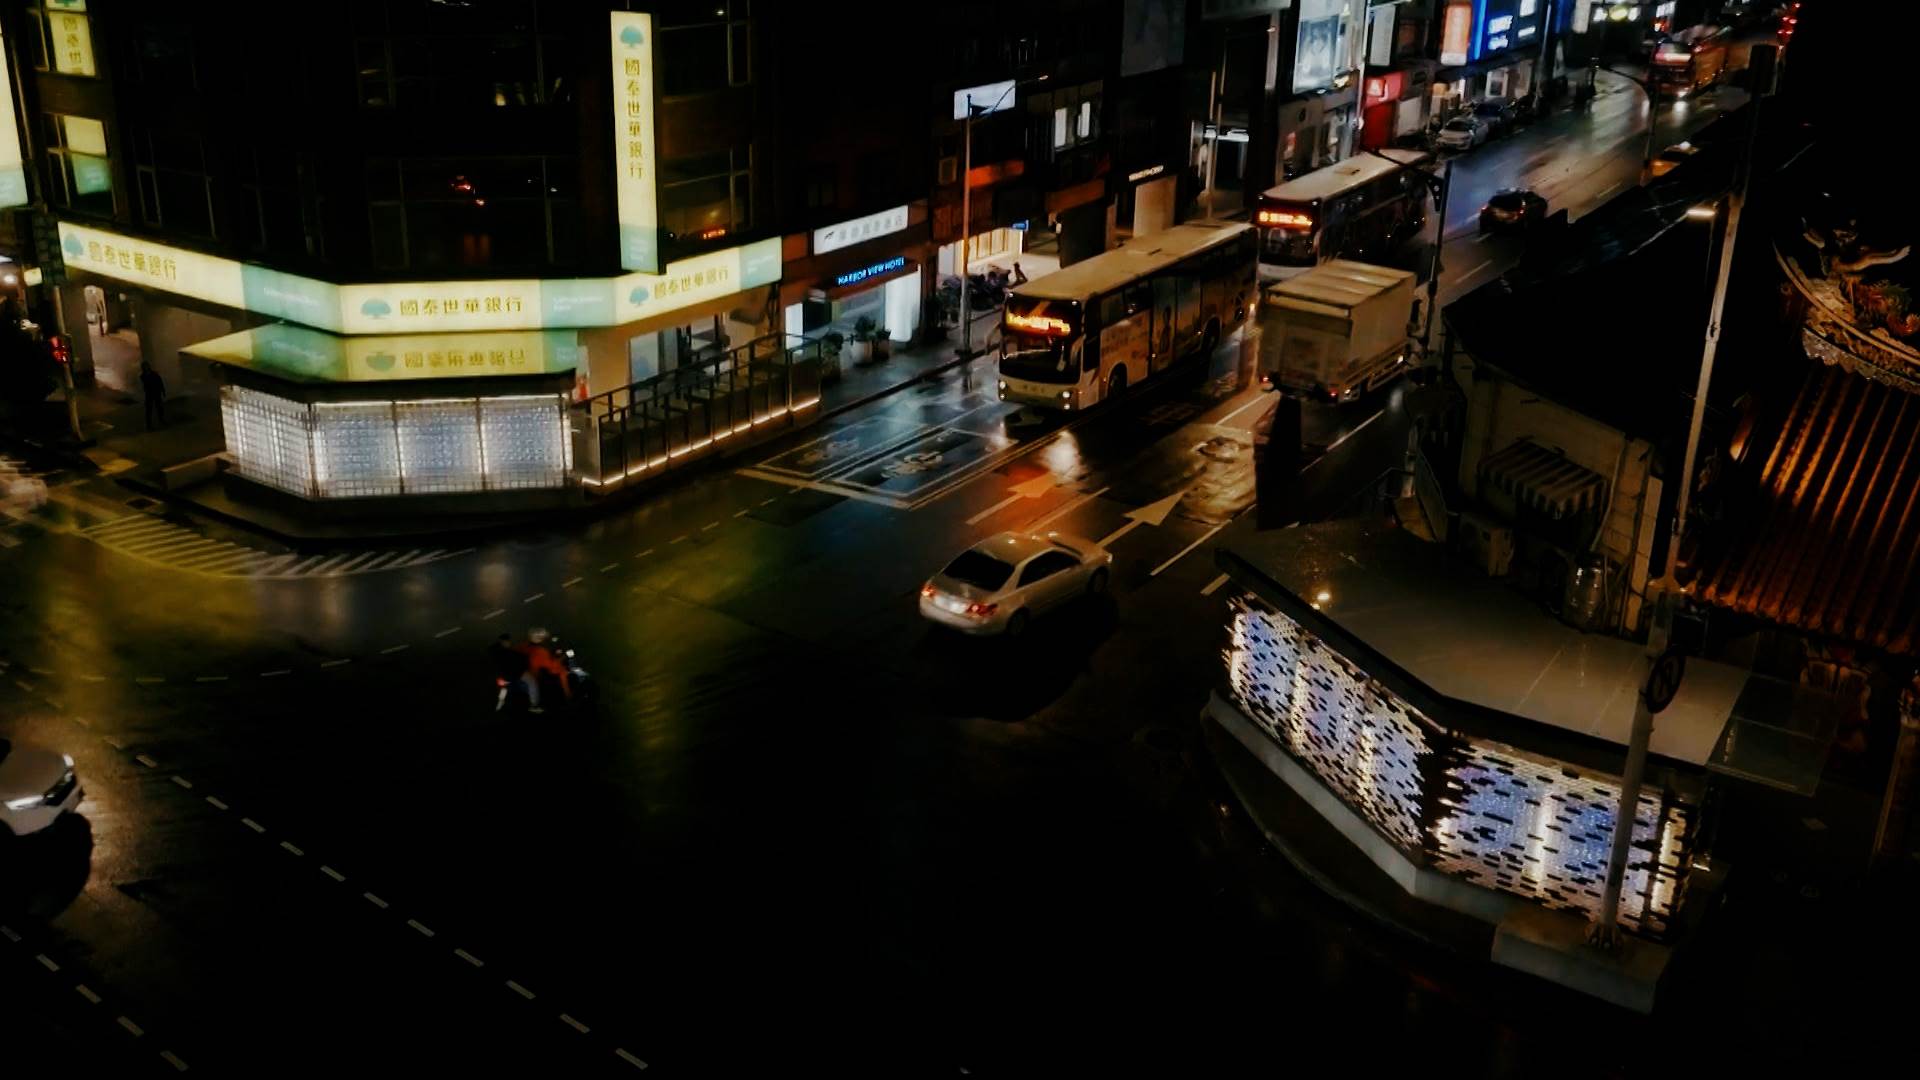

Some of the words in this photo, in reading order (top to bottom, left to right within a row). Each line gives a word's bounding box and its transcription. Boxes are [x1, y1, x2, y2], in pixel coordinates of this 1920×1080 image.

[624, 58, 643, 179] 國泰世華銀行
[87, 240, 177, 281] 國泰世華銀行
[838, 269, 867, 286] HARBOR
[867, 262, 885, 276] VIEW
[885, 256, 905, 271] HOTEL
[653, 264, 729, 299] 國泰世華銀行
[400, 297, 521, 316] 國泰世華銀行
